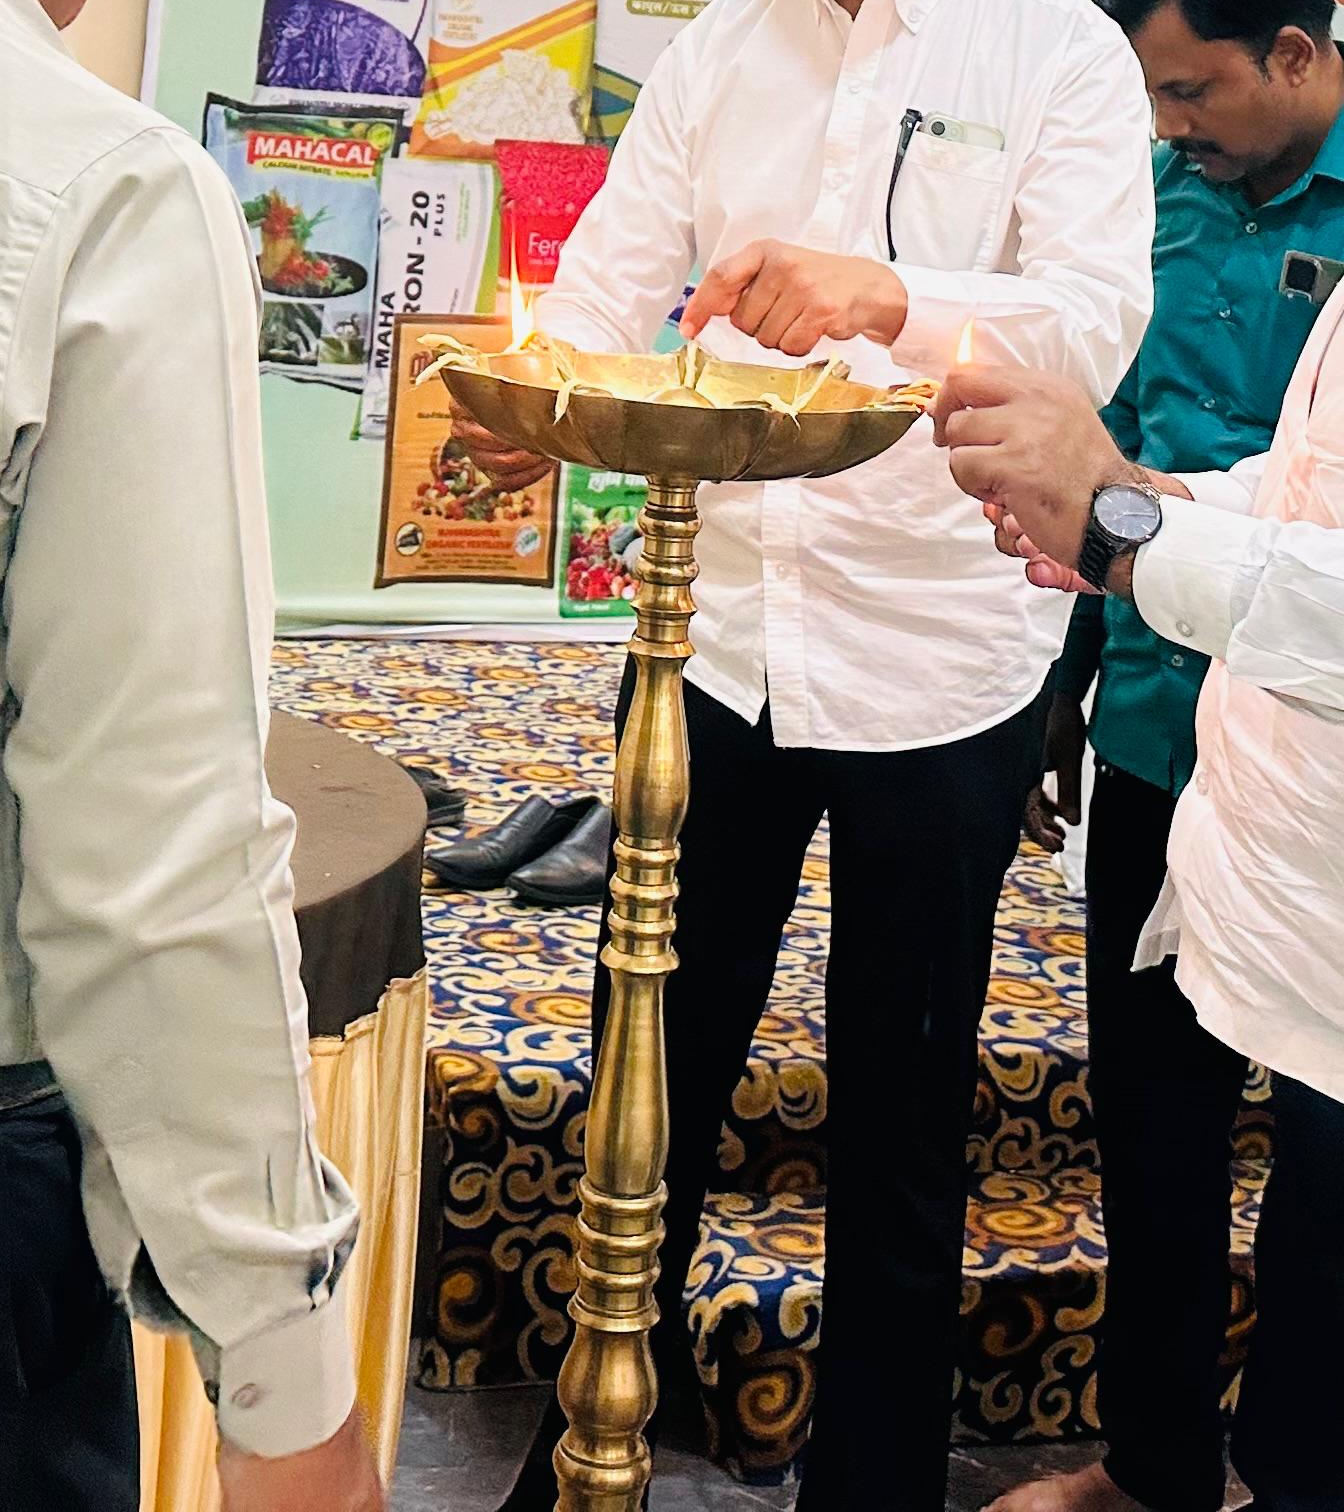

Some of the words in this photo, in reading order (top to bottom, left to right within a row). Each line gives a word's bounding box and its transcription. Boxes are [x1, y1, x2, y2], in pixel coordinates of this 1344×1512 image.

[255, 136, 376, 166] MAHACAL
[410, 190, 431, 230] 20
[433, 193, 446, 237] PLUS
[527, 231, 565, 257] Fer
[375, 290, 397, 369] MAHA
